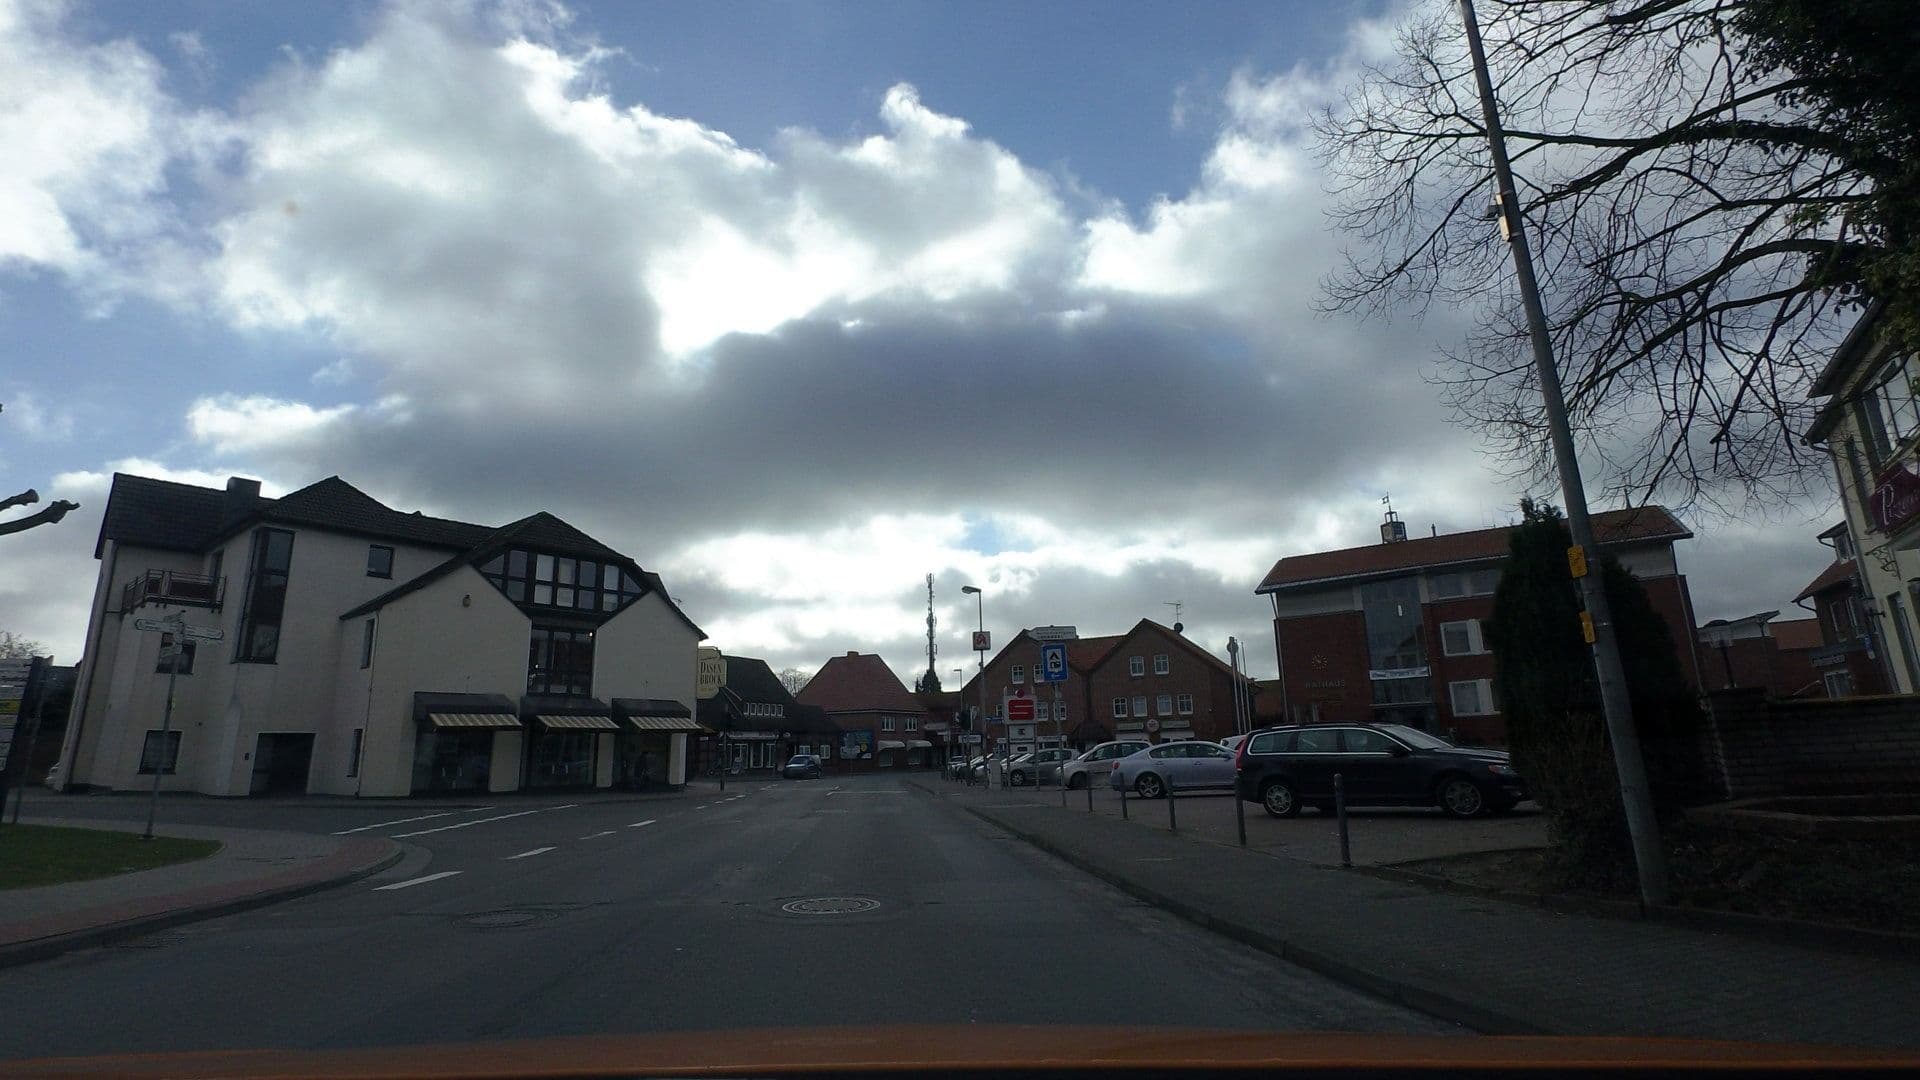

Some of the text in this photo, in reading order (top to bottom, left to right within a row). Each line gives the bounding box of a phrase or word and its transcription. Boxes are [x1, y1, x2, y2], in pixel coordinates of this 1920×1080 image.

[700, 661, 722, 674] DASEN
[700, 674, 722, 685] BROCK
[1304, 679, 1345, 689] RATHAUS
